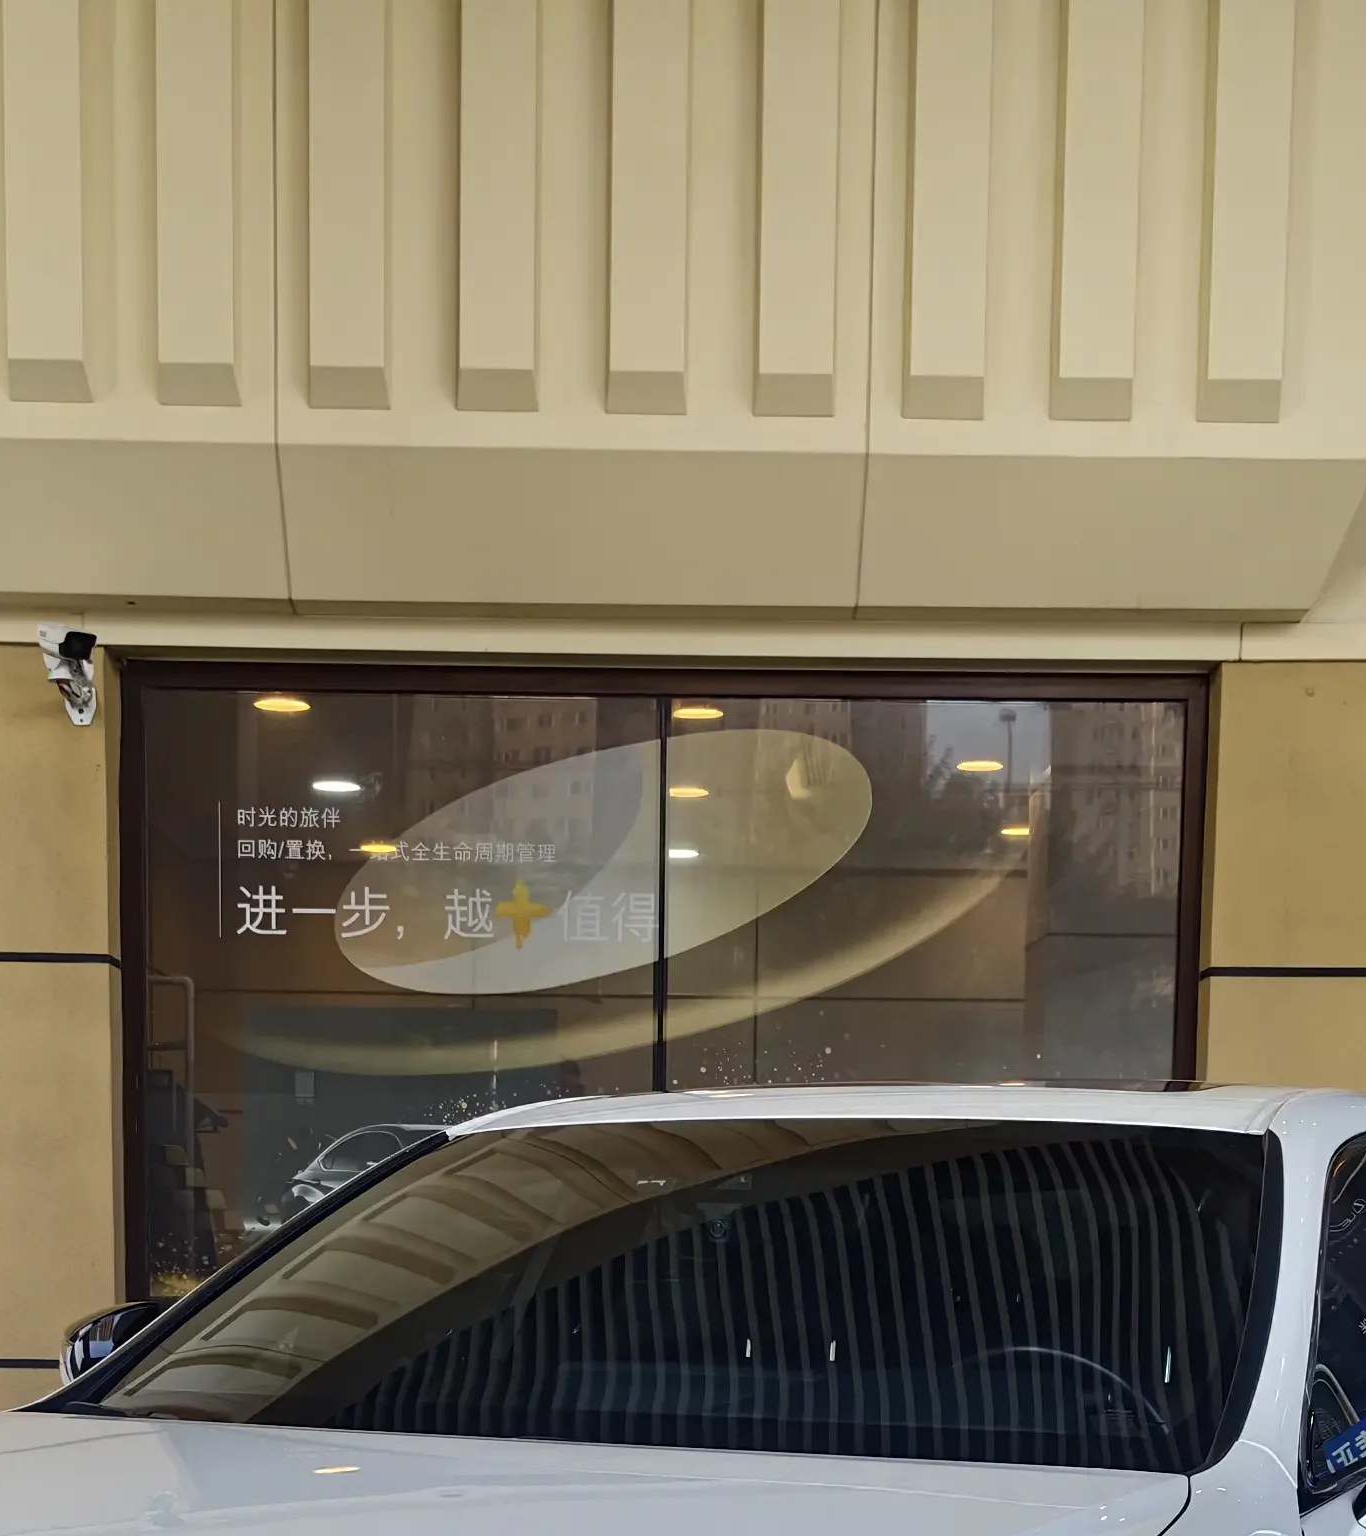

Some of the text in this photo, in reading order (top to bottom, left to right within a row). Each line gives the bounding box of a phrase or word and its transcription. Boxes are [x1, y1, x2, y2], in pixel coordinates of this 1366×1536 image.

[237, 806, 341, 829] 时光的旅伴
